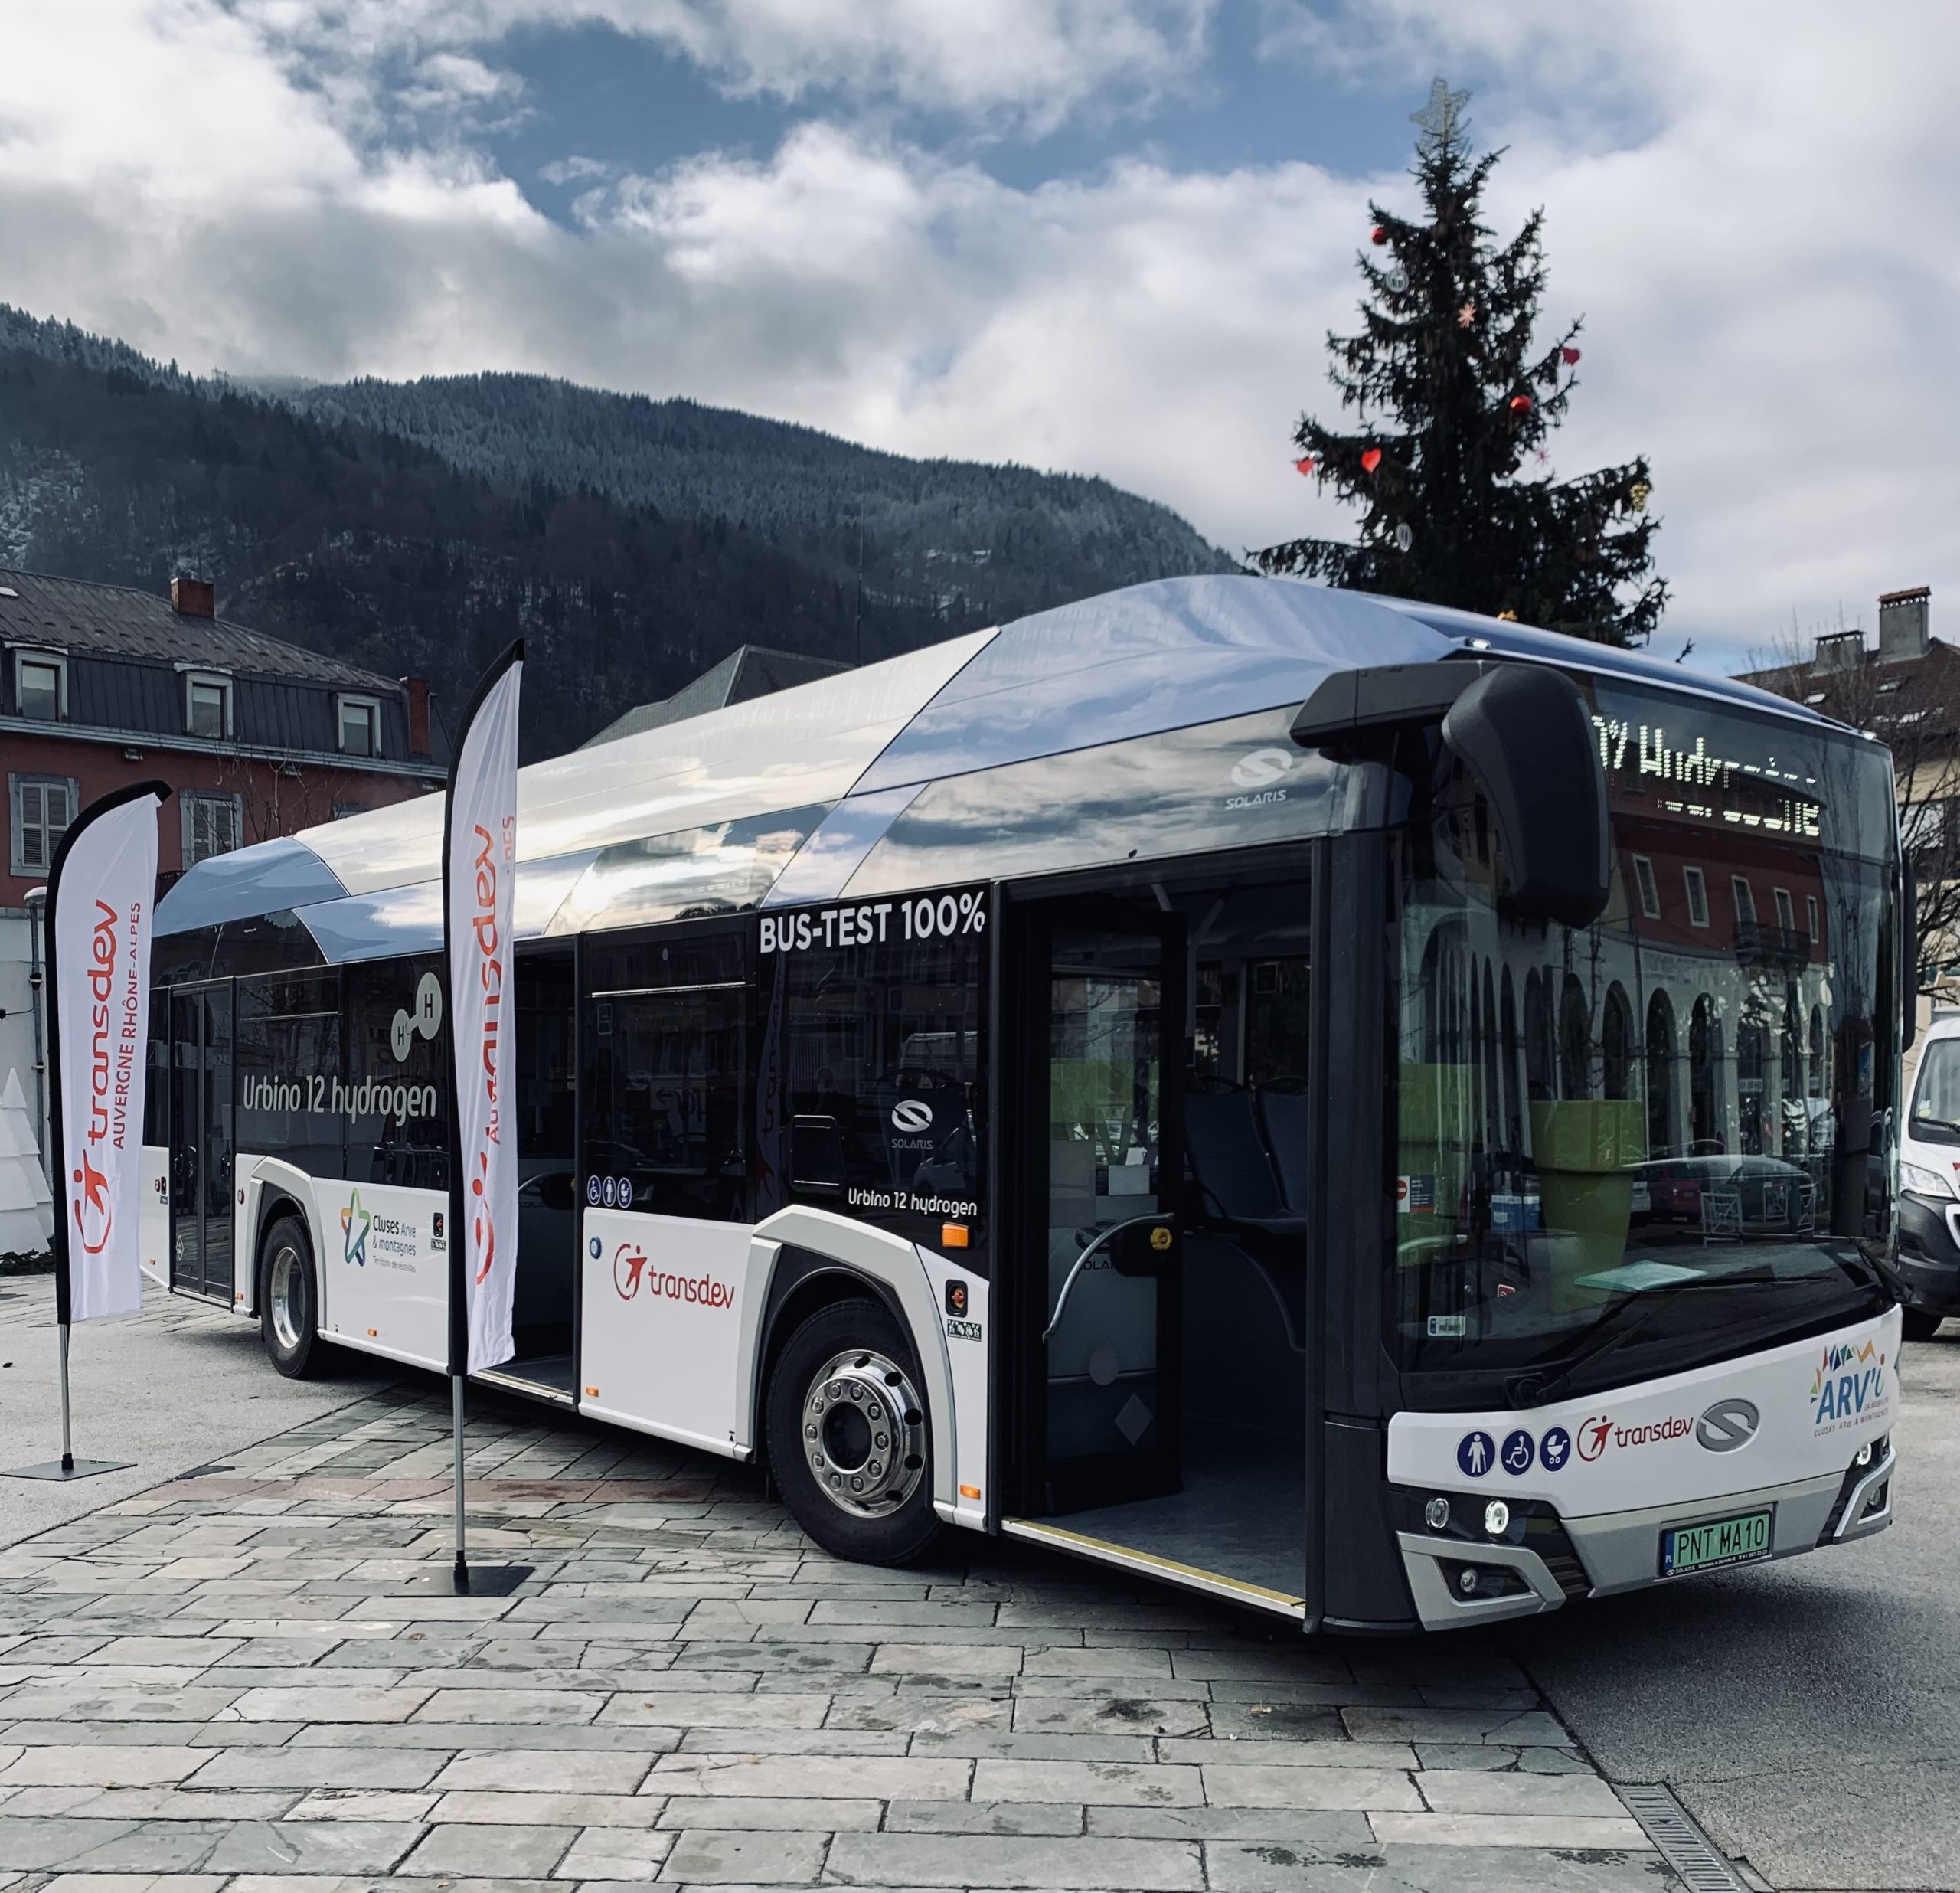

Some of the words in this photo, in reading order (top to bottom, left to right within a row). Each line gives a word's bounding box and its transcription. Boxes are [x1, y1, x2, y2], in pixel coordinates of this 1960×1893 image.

[1225, 790, 1287, 810] SOLARIS
[760, 904, 892, 953] BUS-TEST
[901, 891, 986, 940] 100%
[122, 902, 141, 1039] RHÔNE-ALPES
[424, 993, 433, 1018] H
[87, 899, 118, 1146] transdev
[397, 1026, 405, 1046] H
[113, 1043, 134, 1150] AUVERGNE
[243, 1074, 301, 1112] Urbino
[307, 1075, 325, 1113] 12
[332, 1074, 436, 1126] hydrogen
[891, 1139, 933, 1150] SOLARIS
[848, 1188, 890, 1208] Urbino
[894, 1192, 906, 1209] 12
[911, 1193, 978, 1218] hydrogen
[373, 1215, 400, 1235] Cluses
[401, 1223, 416, 1238] Arve
[372, 1235, 377, 1249] &
[379, 1238, 416, 1257] montagnes
[648, 1265, 735, 1309] transdev
[1615, 1416, 1694, 1448] transdev
[1677, 1528, 1714, 1564] PNT
[1720, 1519, 1765, 1555] MA10
[1665, 1555, 1673, 1563] PL
